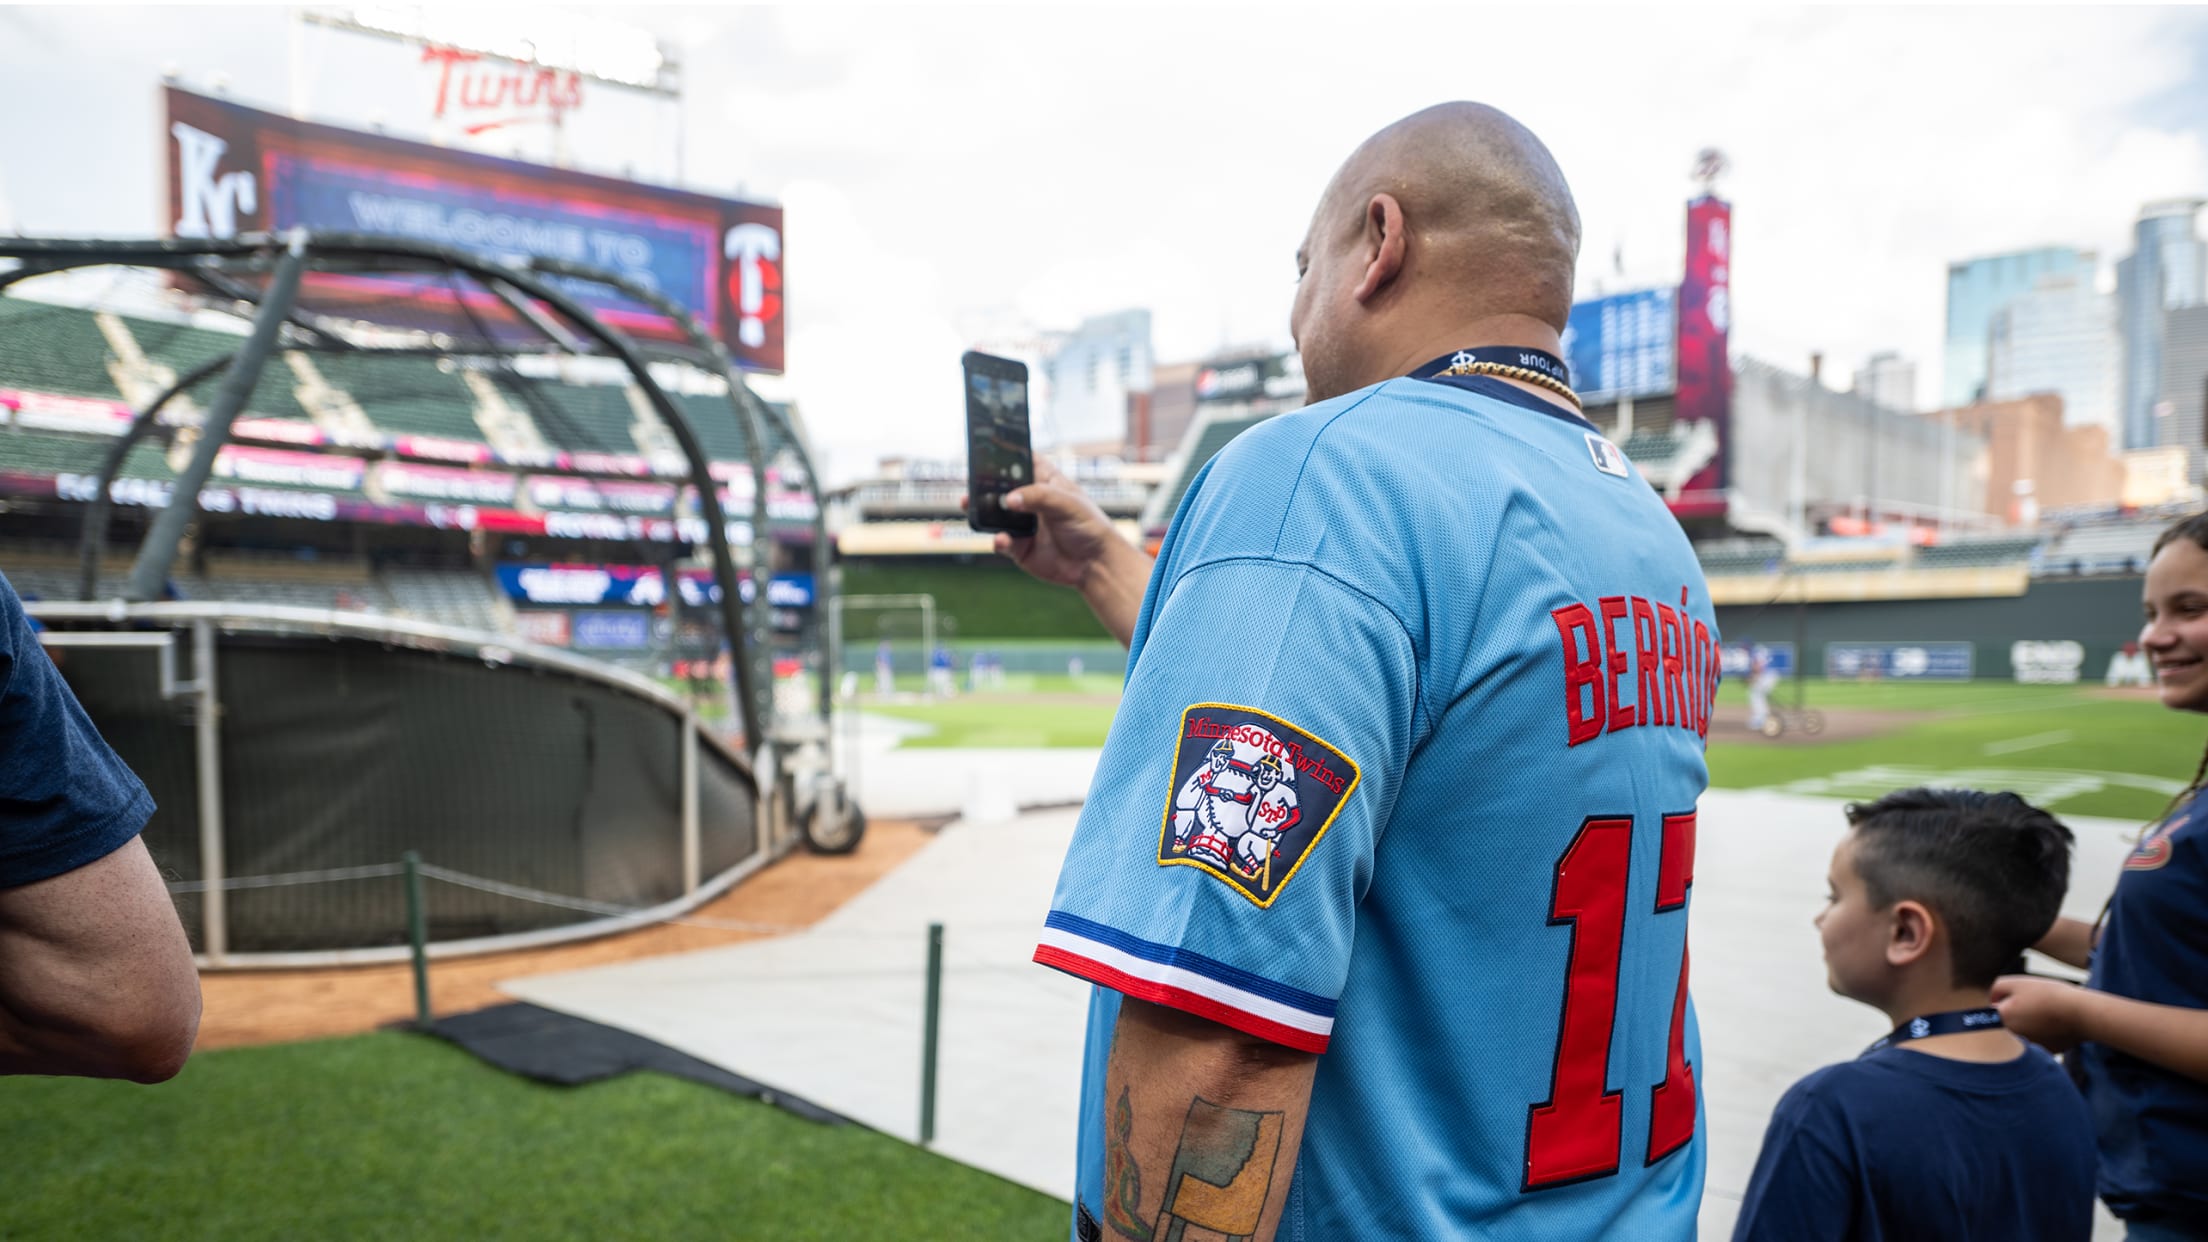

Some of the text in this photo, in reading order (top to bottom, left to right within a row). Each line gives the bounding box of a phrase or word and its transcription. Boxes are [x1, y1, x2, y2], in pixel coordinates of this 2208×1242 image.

[421, 44, 584, 120] Twins
[346, 190, 654, 268] WELCOME TO
[1519, 352, 1550, 372] TOUR
[1186, 716, 1346, 795] Minnesota Twins
[1519, 808, 1698, 1194] 17
